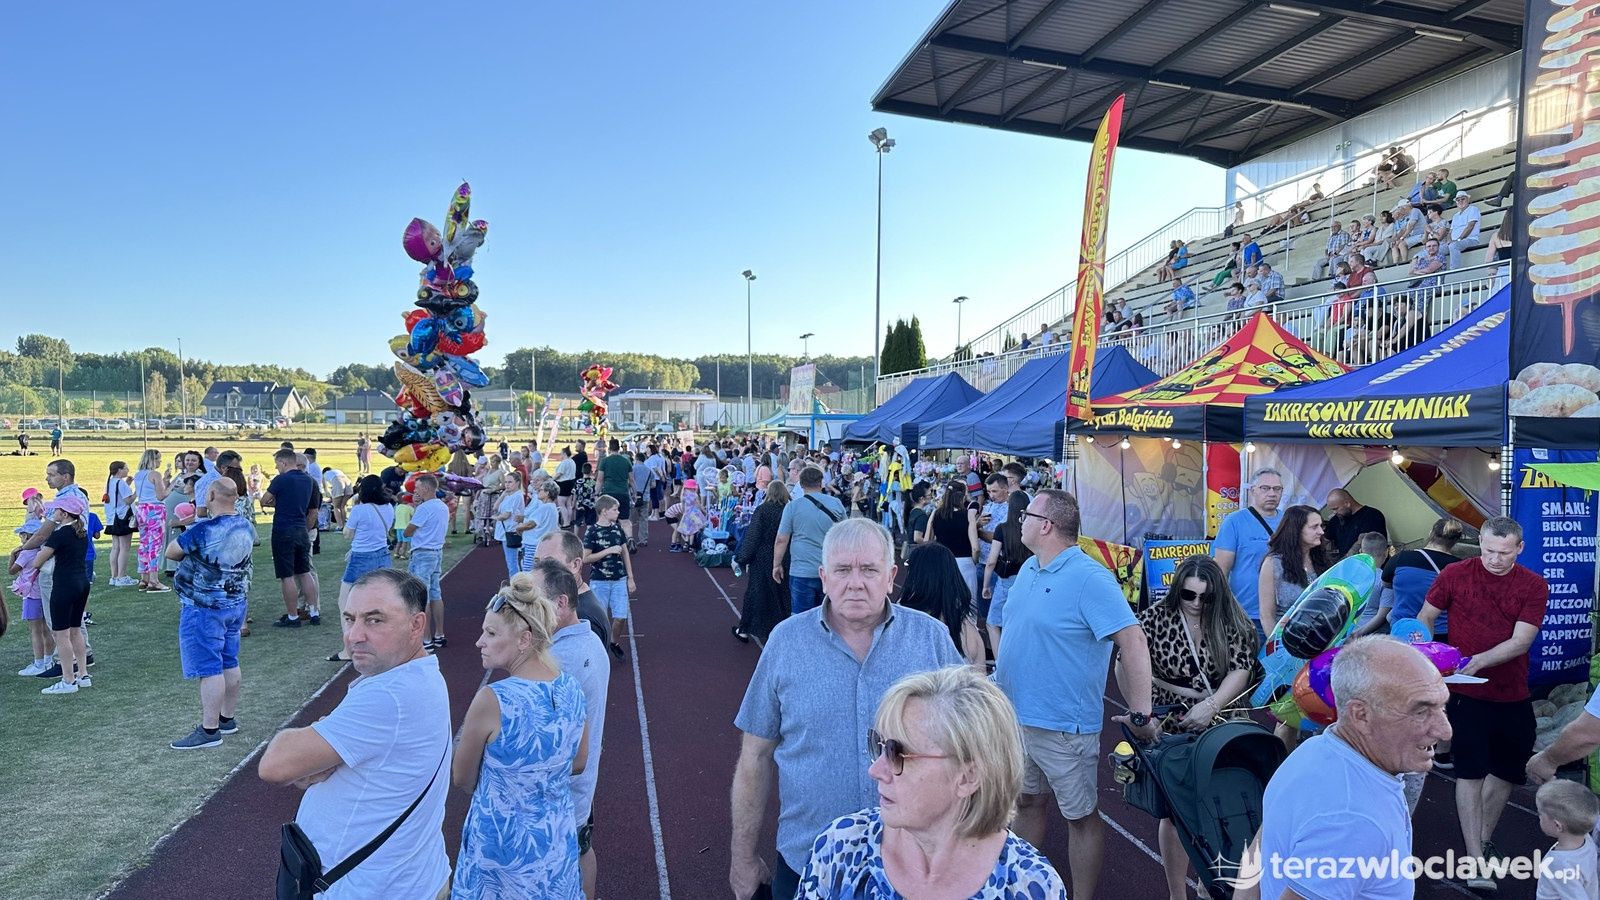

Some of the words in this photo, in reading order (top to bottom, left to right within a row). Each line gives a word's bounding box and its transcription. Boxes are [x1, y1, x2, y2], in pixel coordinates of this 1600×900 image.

[1364, 394, 1471, 420] ZIEMNIAK
[1117, 408, 1174, 432] Belgijskie
[1308, 423, 1332, 438] NA
[1334, 422, 1394, 439] PATYKU
[1541, 502, 1590, 516] SMAKI:
[1542, 521, 1582, 532] BEKON
[1542, 552, 1596, 563] CZOSNEK
[1543, 568, 1565, 579] SER
[1541, 642, 1564, 656] SÓL
[1541, 660, 1562, 671] MIX
